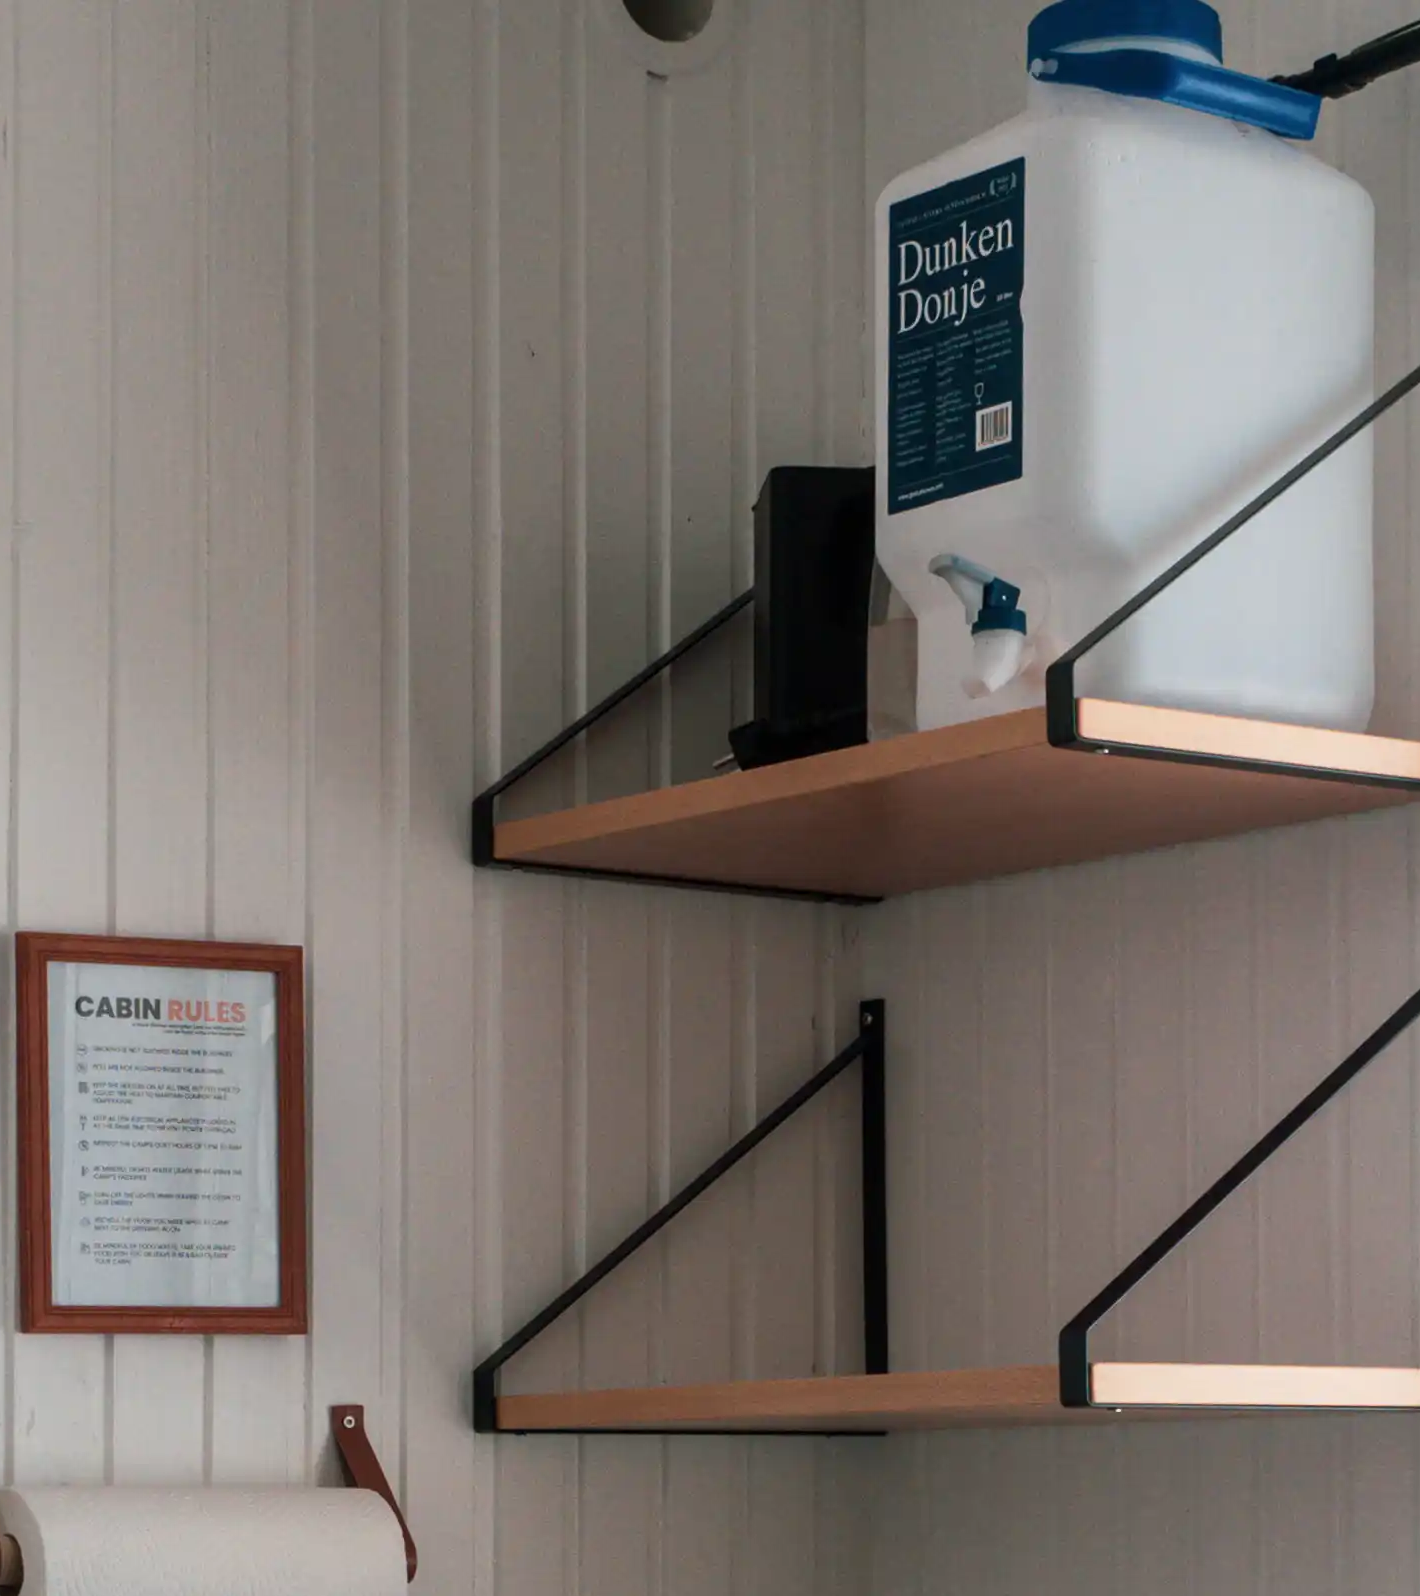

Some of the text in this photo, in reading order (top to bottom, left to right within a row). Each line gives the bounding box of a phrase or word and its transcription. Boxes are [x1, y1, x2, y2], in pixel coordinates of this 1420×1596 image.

[896, 219, 1014, 286] Dunken
[896, 268, 986, 335] Donje
[75, 996, 246, 1023] CABIN RULES
